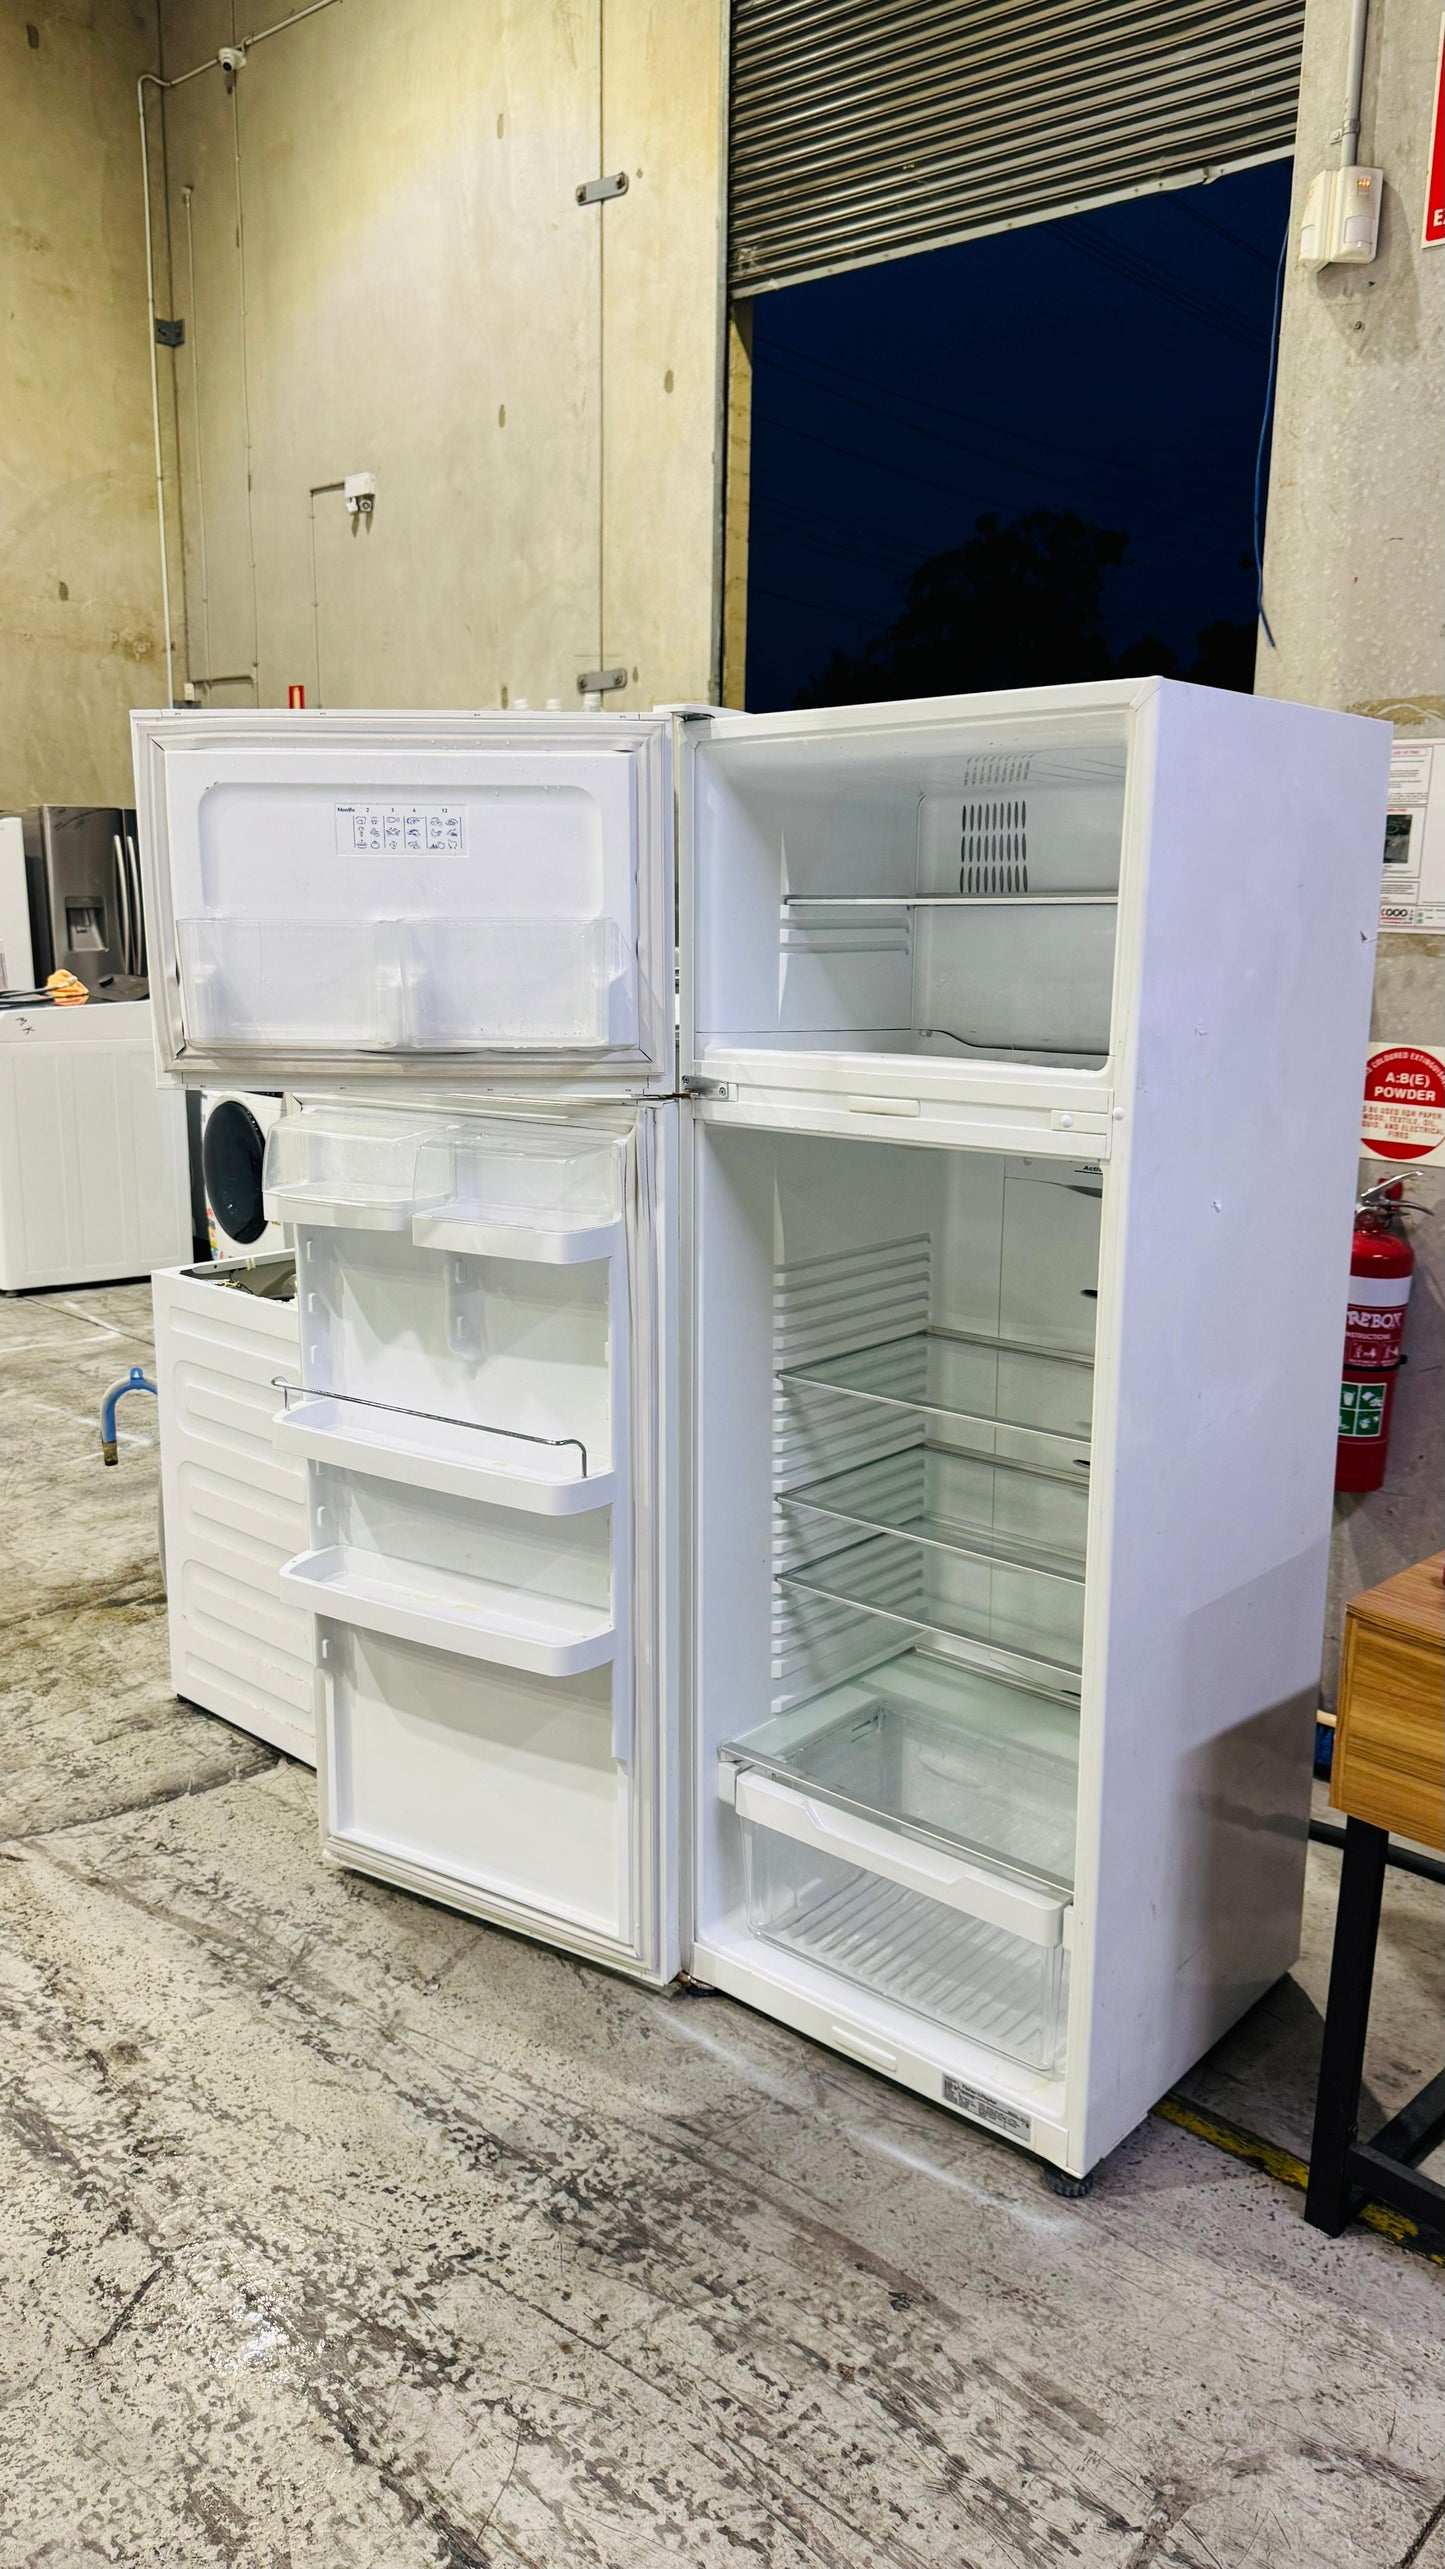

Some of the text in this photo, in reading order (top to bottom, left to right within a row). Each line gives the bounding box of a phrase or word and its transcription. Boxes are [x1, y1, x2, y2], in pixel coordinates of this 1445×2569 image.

[1433, 208, 1445, 227] E
[1371, 1052, 1409, 1068] COLOURED
[1385, 1072, 1430, 1088] A:B(E)
[1374, 1086, 1436, 1102] POWDER
[1381, 1107, 1399, 1116] USED
[1402, 1109, 1416, 1117] FOR
[1384, 1123, 1399, 1131] AND
[1401, 1124, 1445, 1135] ELECTRICAL
[1388, 1131, 1409, 1139] FIRES
